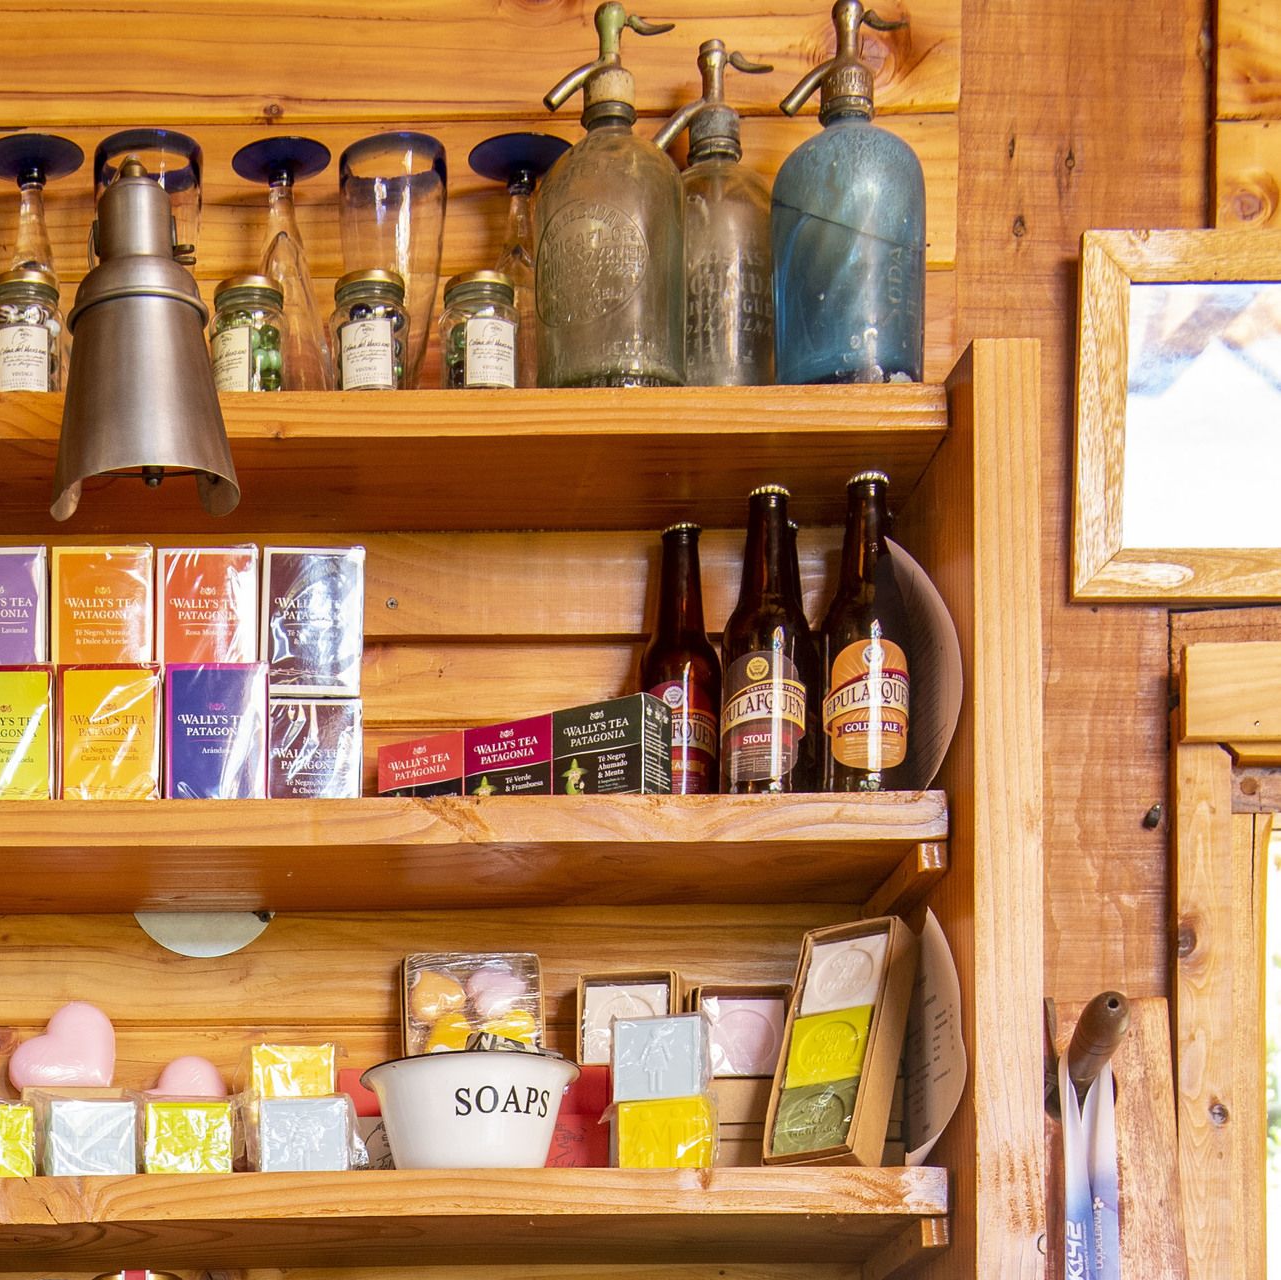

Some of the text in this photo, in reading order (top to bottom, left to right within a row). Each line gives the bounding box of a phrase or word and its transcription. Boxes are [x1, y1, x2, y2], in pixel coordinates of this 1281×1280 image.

[9, 597, 33, 607] TEA
[65, 597, 140, 609] WALLY'S TEA
[170, 598, 220, 609] WALLY'S
[122, 715, 146, 724] TEA
[178, 714, 228, 725] WALLY'S
[563, 718, 629, 737] WALLY'S TEA
[884, 722, 899, 732] ALE
[570, 730, 625, 747] PATAGONIA
[743, 734, 773, 745] STOUT
[474, 736, 538, 755] WALLY'S TEA
[388, 752, 451, 771] WALLY'S TEA
[481, 747, 534, 765] PATAGONIA
[597, 752, 626, 763] Té Negro
[598, 760, 628, 771] Ahumado
[395, 764, 446, 781] PATAGONIA
[604, 769, 624, 777] Menta
[514, 774, 531, 783] Verde
[454, 1086, 551, 1119] SOAPS
